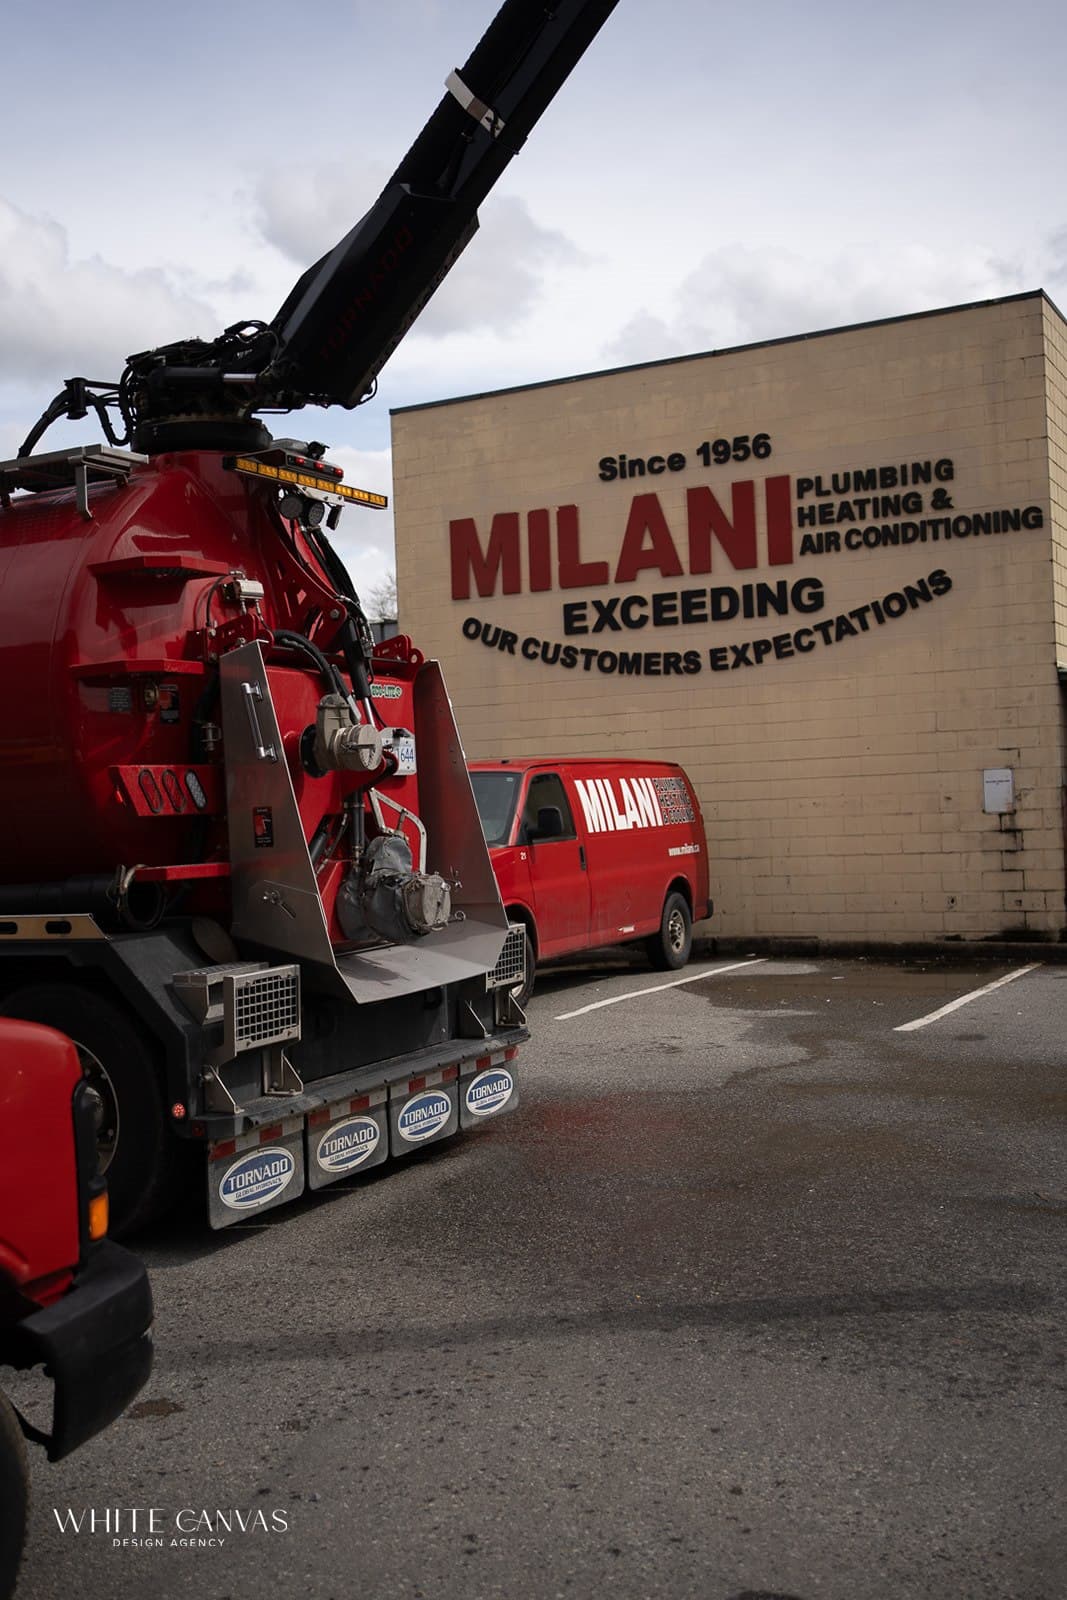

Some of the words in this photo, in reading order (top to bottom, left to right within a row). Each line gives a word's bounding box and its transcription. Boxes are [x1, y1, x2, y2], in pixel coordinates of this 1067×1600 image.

[598, 453, 687, 482] Since
[695, 433, 772, 467] 1956
[796, 458, 954, 499] PLUMBING
[797, 492, 923, 527] HEATING
[931, 488, 954, 511] &
[844, 506, 1044, 551] CONDITIONING
[449, 475, 794, 600] MILANI
[462, 617, 519, 655] OUR
[521, 637, 702, 676] CUSTOMERS
[709, 569, 953, 671] EXPECTATIONS
[563, 577, 825, 635] EXCEEDING
[574, 777, 664, 834] MILANI
[472, 1078, 509, 1101] TORNADO
[403, 1100, 447, 1126] TORNADO
[323, 1126, 375, 1156] TORNADO
[228, 1157, 290, 1192] TORNADO
